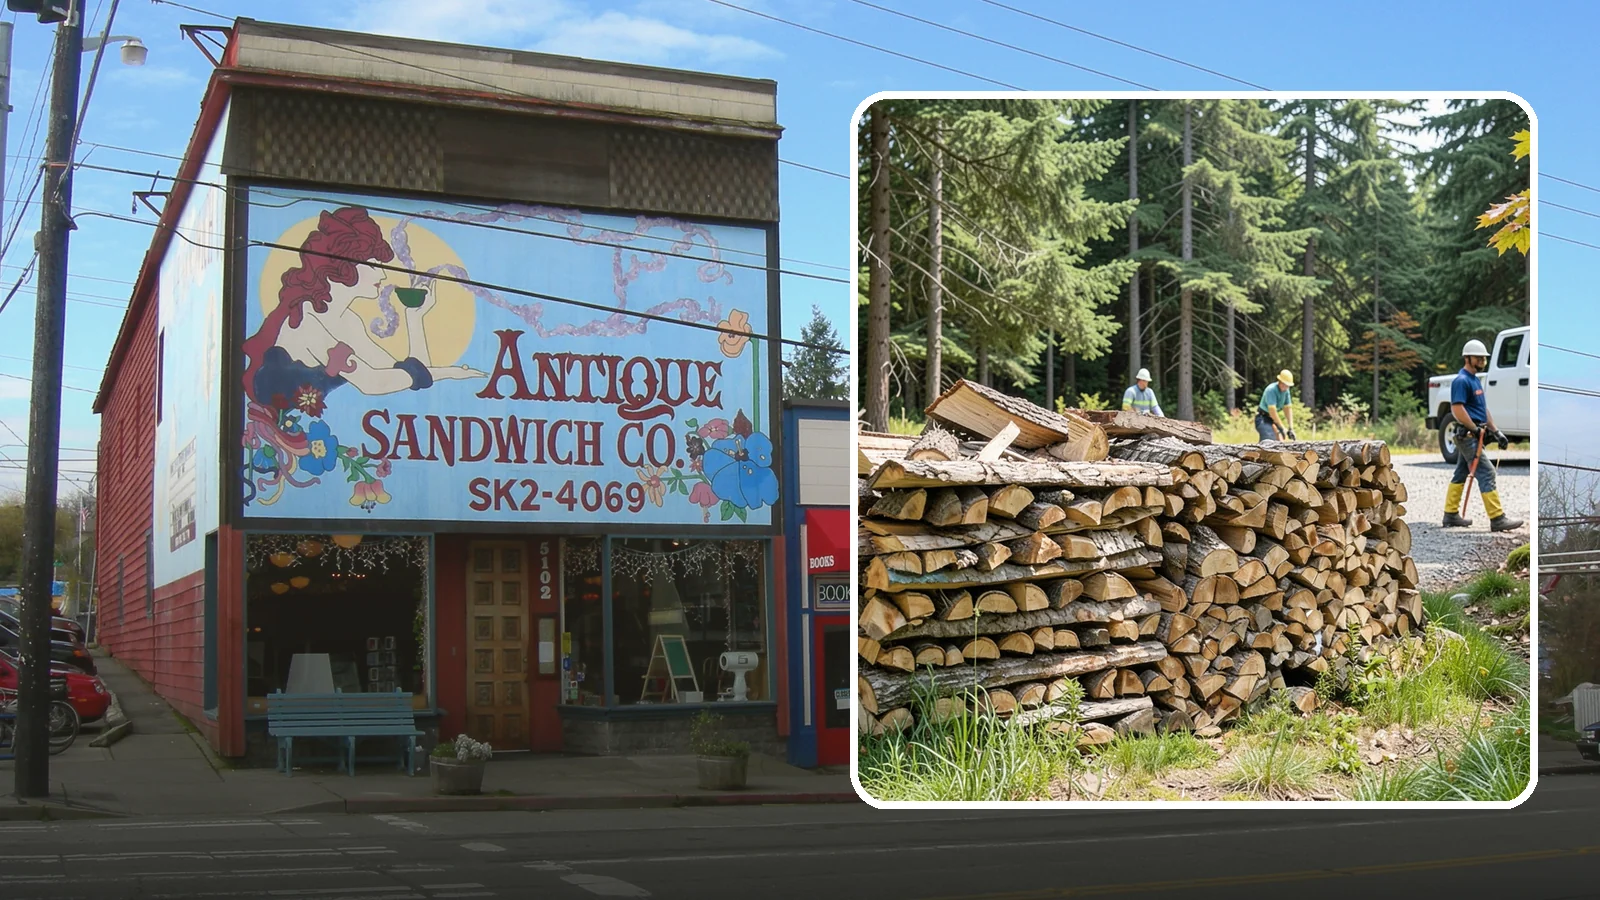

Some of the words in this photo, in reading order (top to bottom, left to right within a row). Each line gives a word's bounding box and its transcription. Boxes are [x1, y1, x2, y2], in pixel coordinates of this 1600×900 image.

[476, 329, 723, 421] ANTIQUE
[361, 408, 604, 467] SANDWICH
[617, 422, 685, 468] CO.
[469, 477, 646, 513] SK2-4069
[539, 541, 552, 600] 5102
[809, 555, 835, 569] BOOKS
